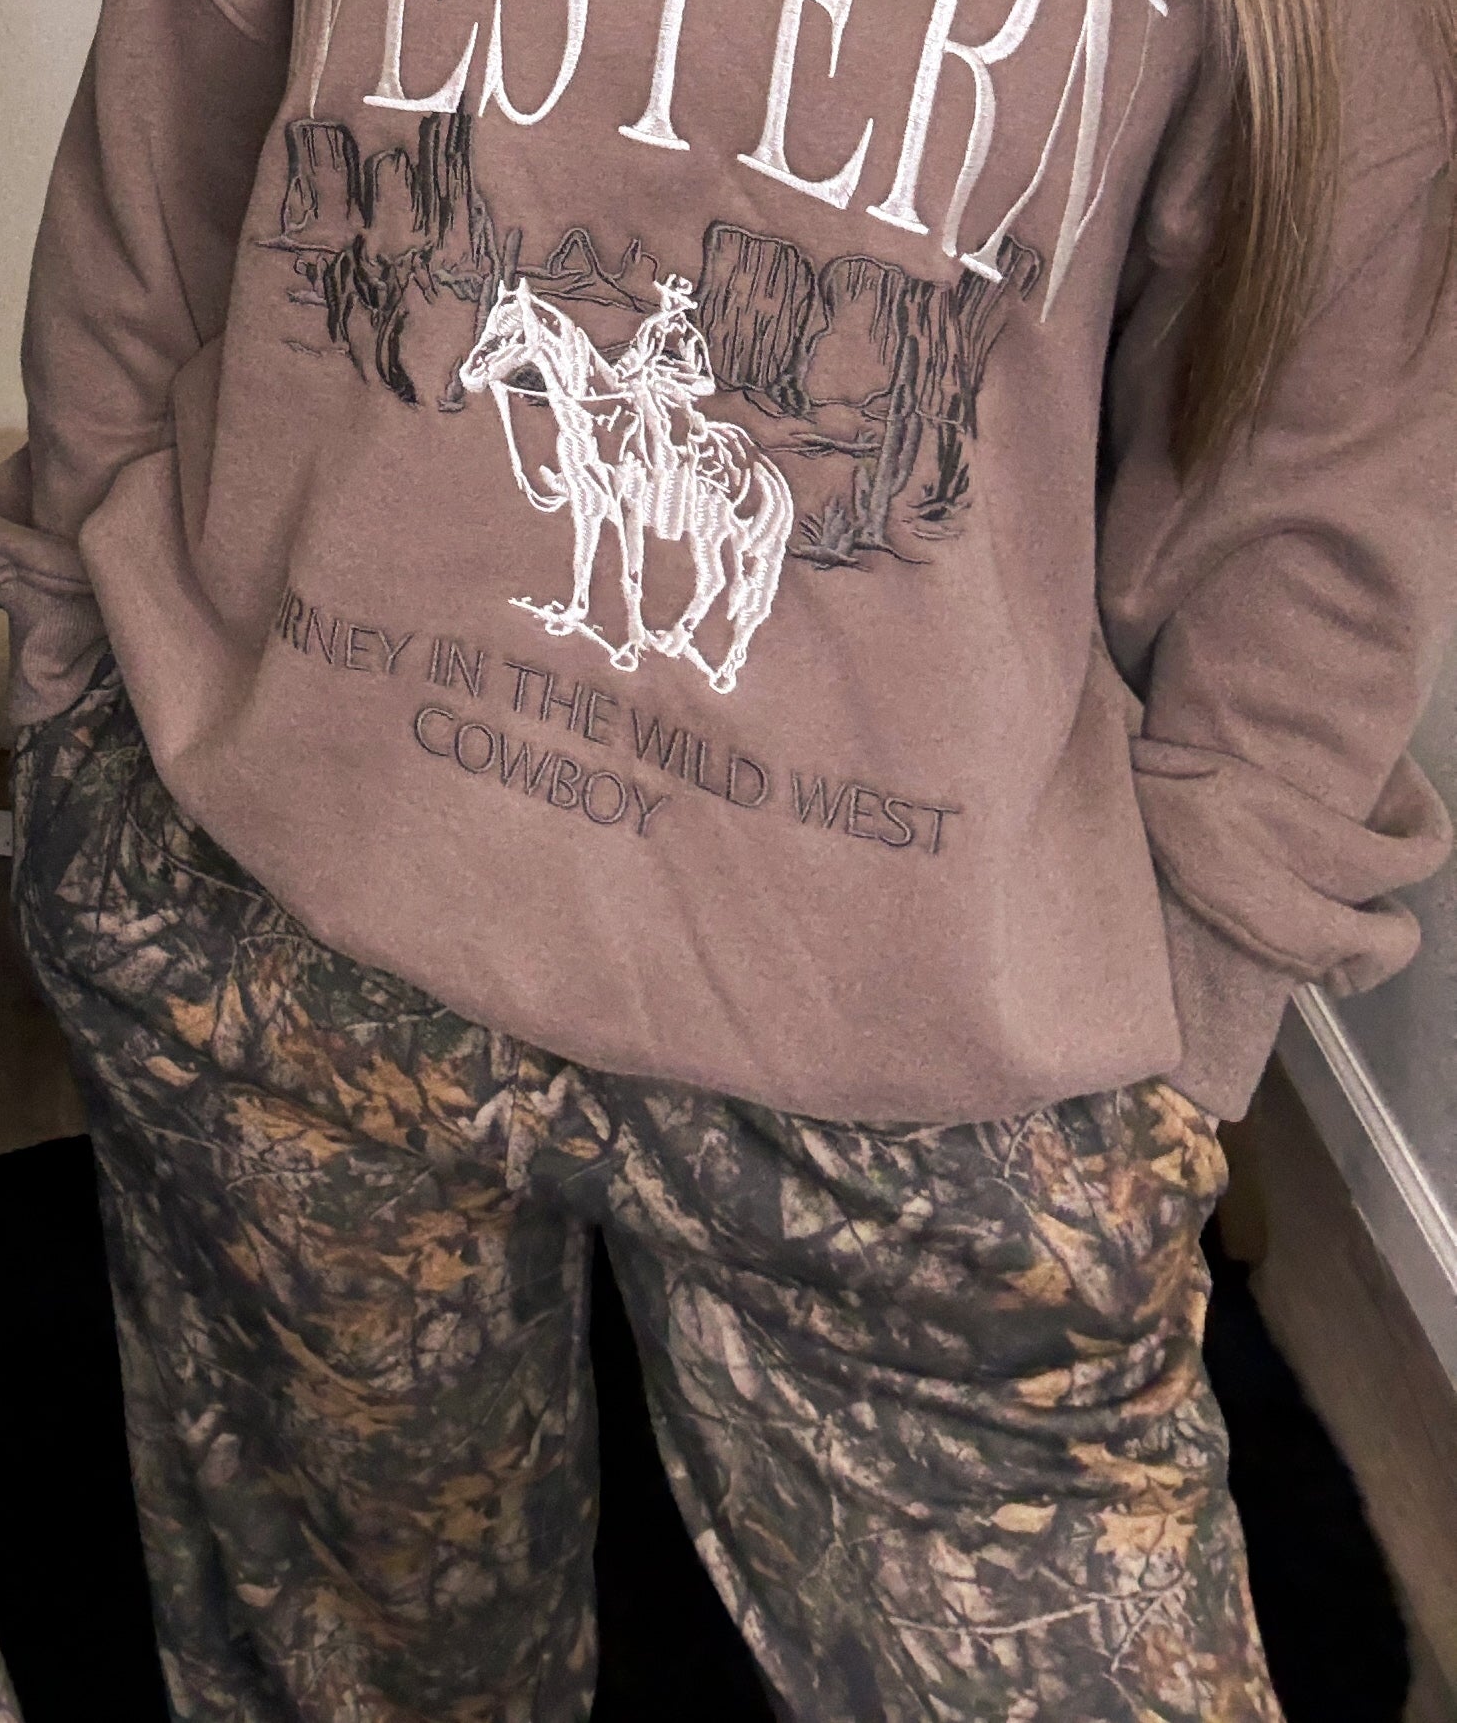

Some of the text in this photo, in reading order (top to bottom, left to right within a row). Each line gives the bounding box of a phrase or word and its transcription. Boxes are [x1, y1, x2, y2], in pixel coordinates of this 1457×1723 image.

[278, 584, 961, 855] RNEY IN THE WILD WEST
[411, 704, 673, 839] COWBOY
